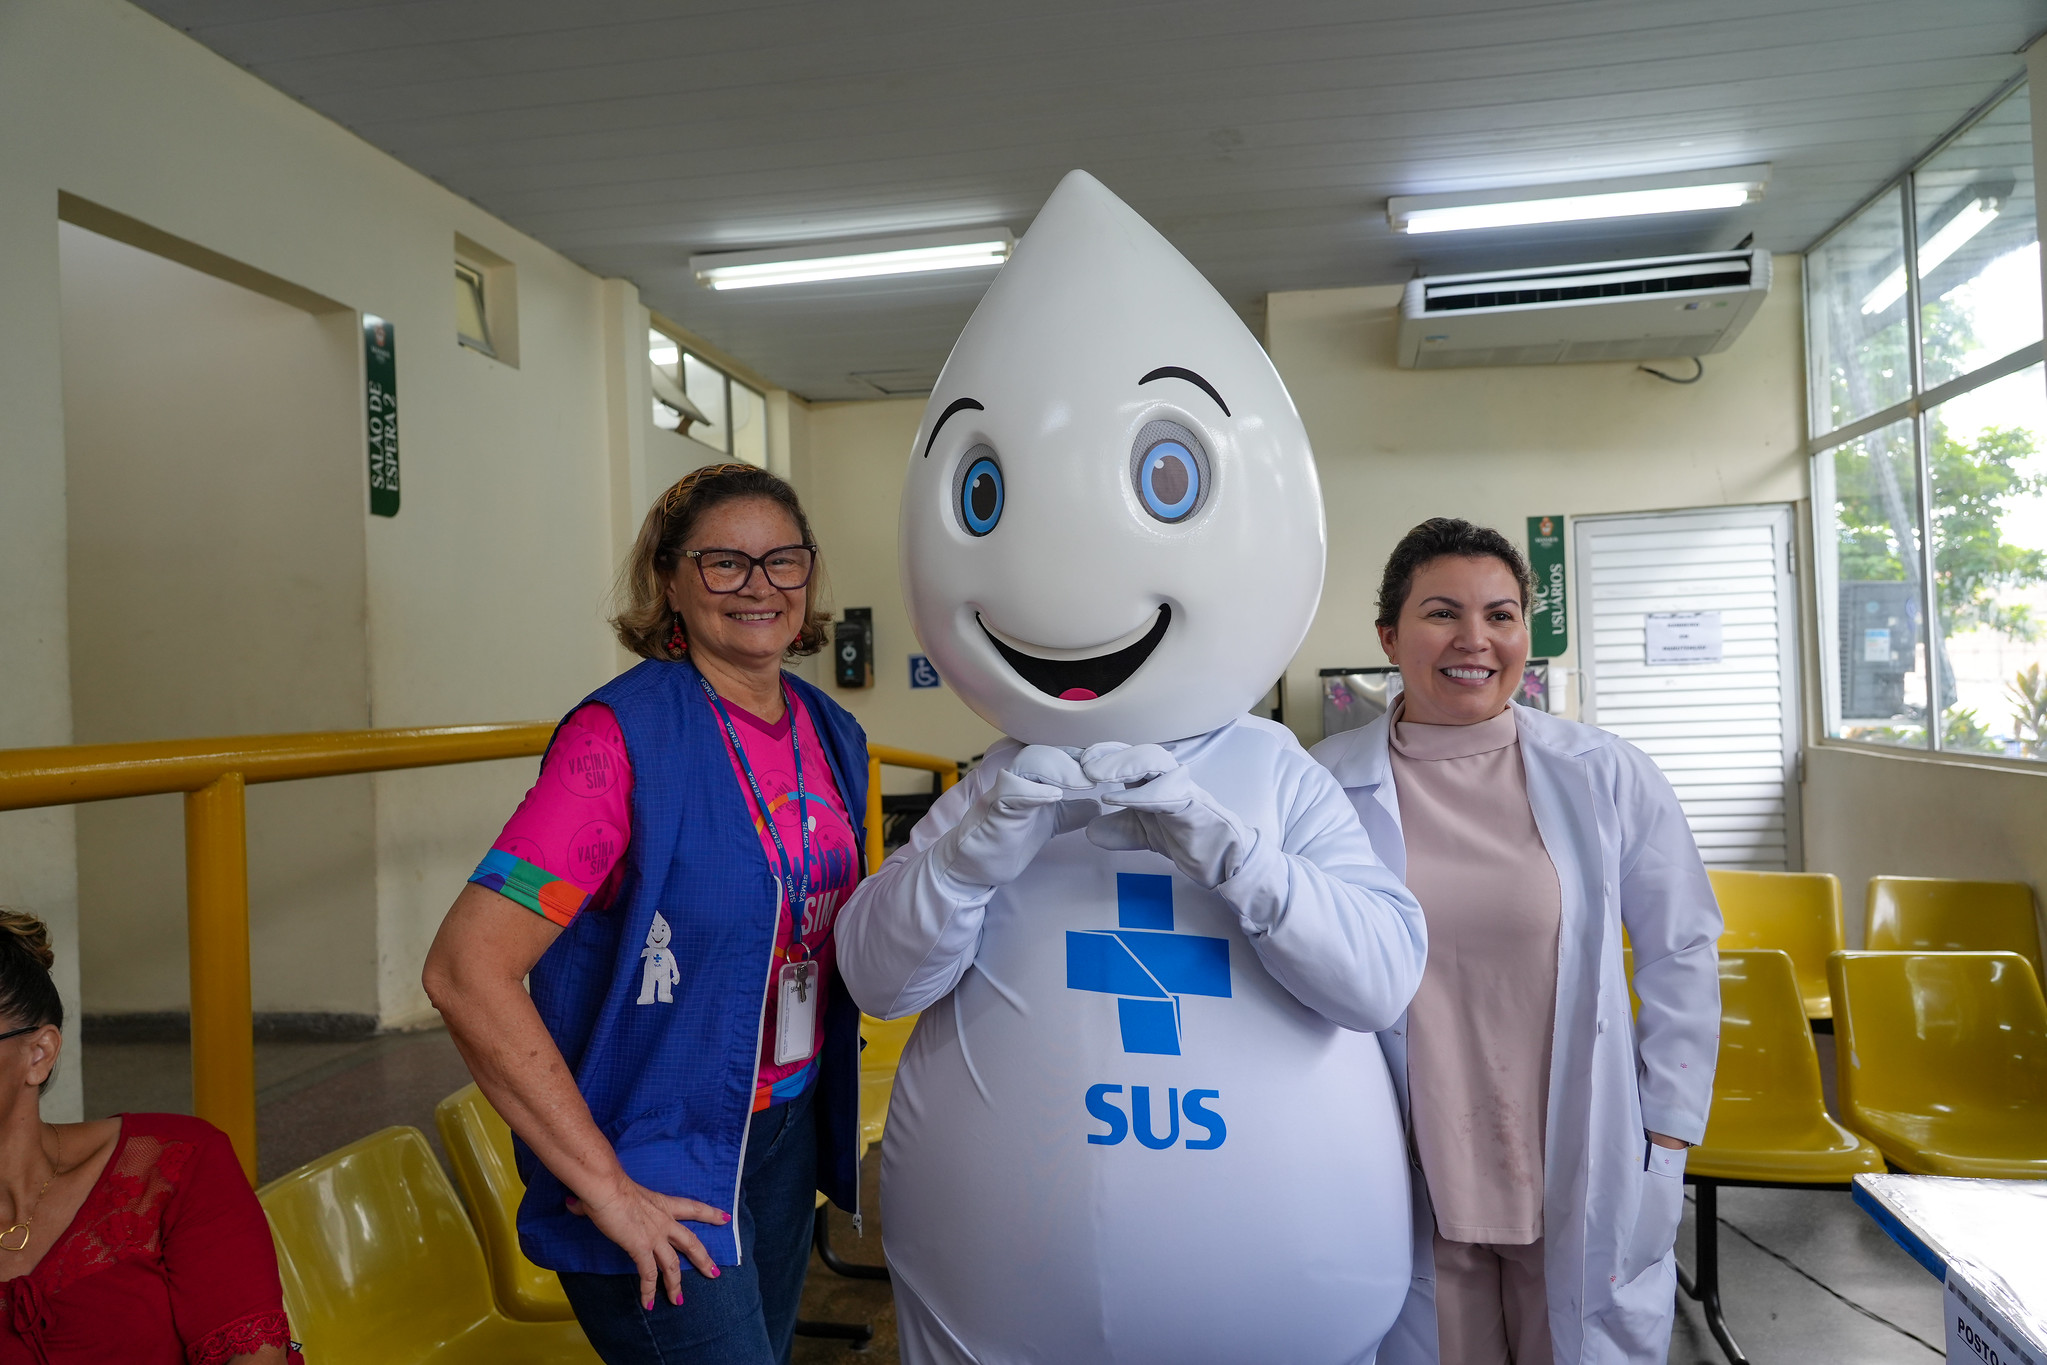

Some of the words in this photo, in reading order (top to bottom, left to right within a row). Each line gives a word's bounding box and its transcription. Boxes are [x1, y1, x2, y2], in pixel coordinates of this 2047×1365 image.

[368, 381, 383, 412] DE
[382, 392, 397, 408] 2
[383, 412, 399, 492] ESPERA
[1533, 584, 1550, 615] WC
[700, 677, 718, 701] SEMSA
[726, 721, 741, 749] SEMSA
[568, 750, 611, 775] VACINA
[585, 770, 607, 790] SIM
[748, 771, 762, 799] SEMSA
[797, 772, 805, 798] SEMSA
[768, 821, 783, 850] SEMSA
[577, 838, 615, 863] VACINA
[590, 857, 609, 876] SIM
[786, 873, 797, 904] SEMSA
[798, 874, 809, 903] SEMSA
[801, 889, 839, 936] SIM
[1085, 1083, 1227, 1150] SUS
[1957, 1315, 2000, 1365] POSTO
